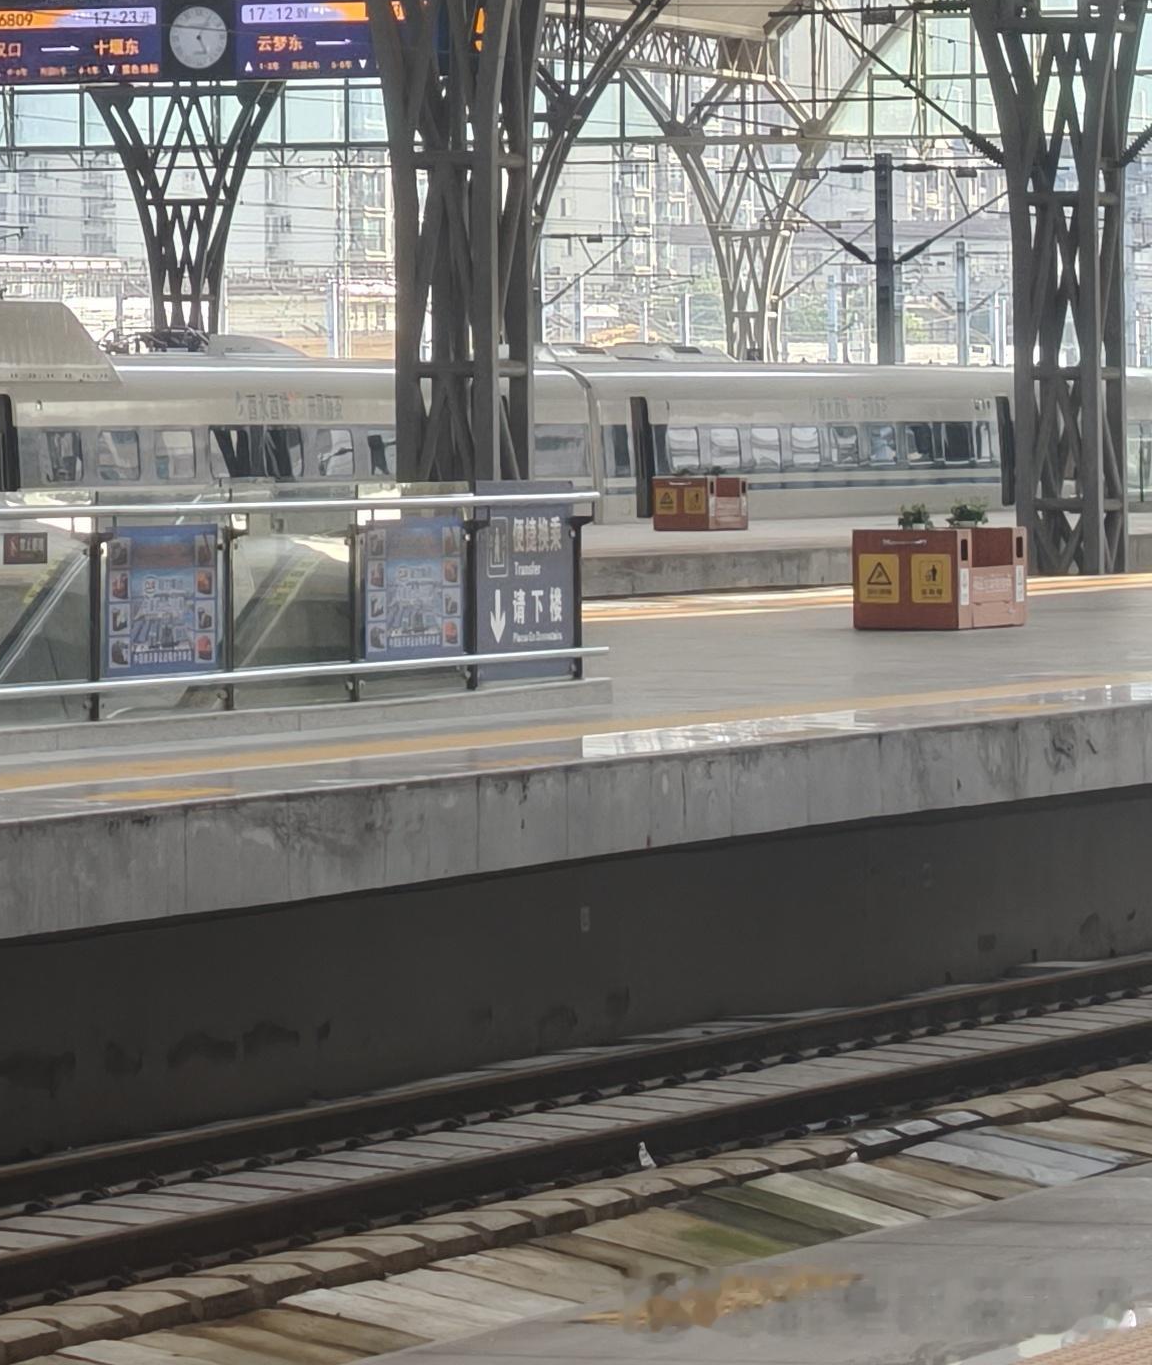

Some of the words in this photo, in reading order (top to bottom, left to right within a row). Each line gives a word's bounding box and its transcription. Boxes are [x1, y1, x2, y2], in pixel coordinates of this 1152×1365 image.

[256, 34, 304, 52] 云梦东
[512, 515, 562, 553] 便捷换乘
[513, 561, 542, 577] Transfer
[511, 586, 563, 625] 请下楼
